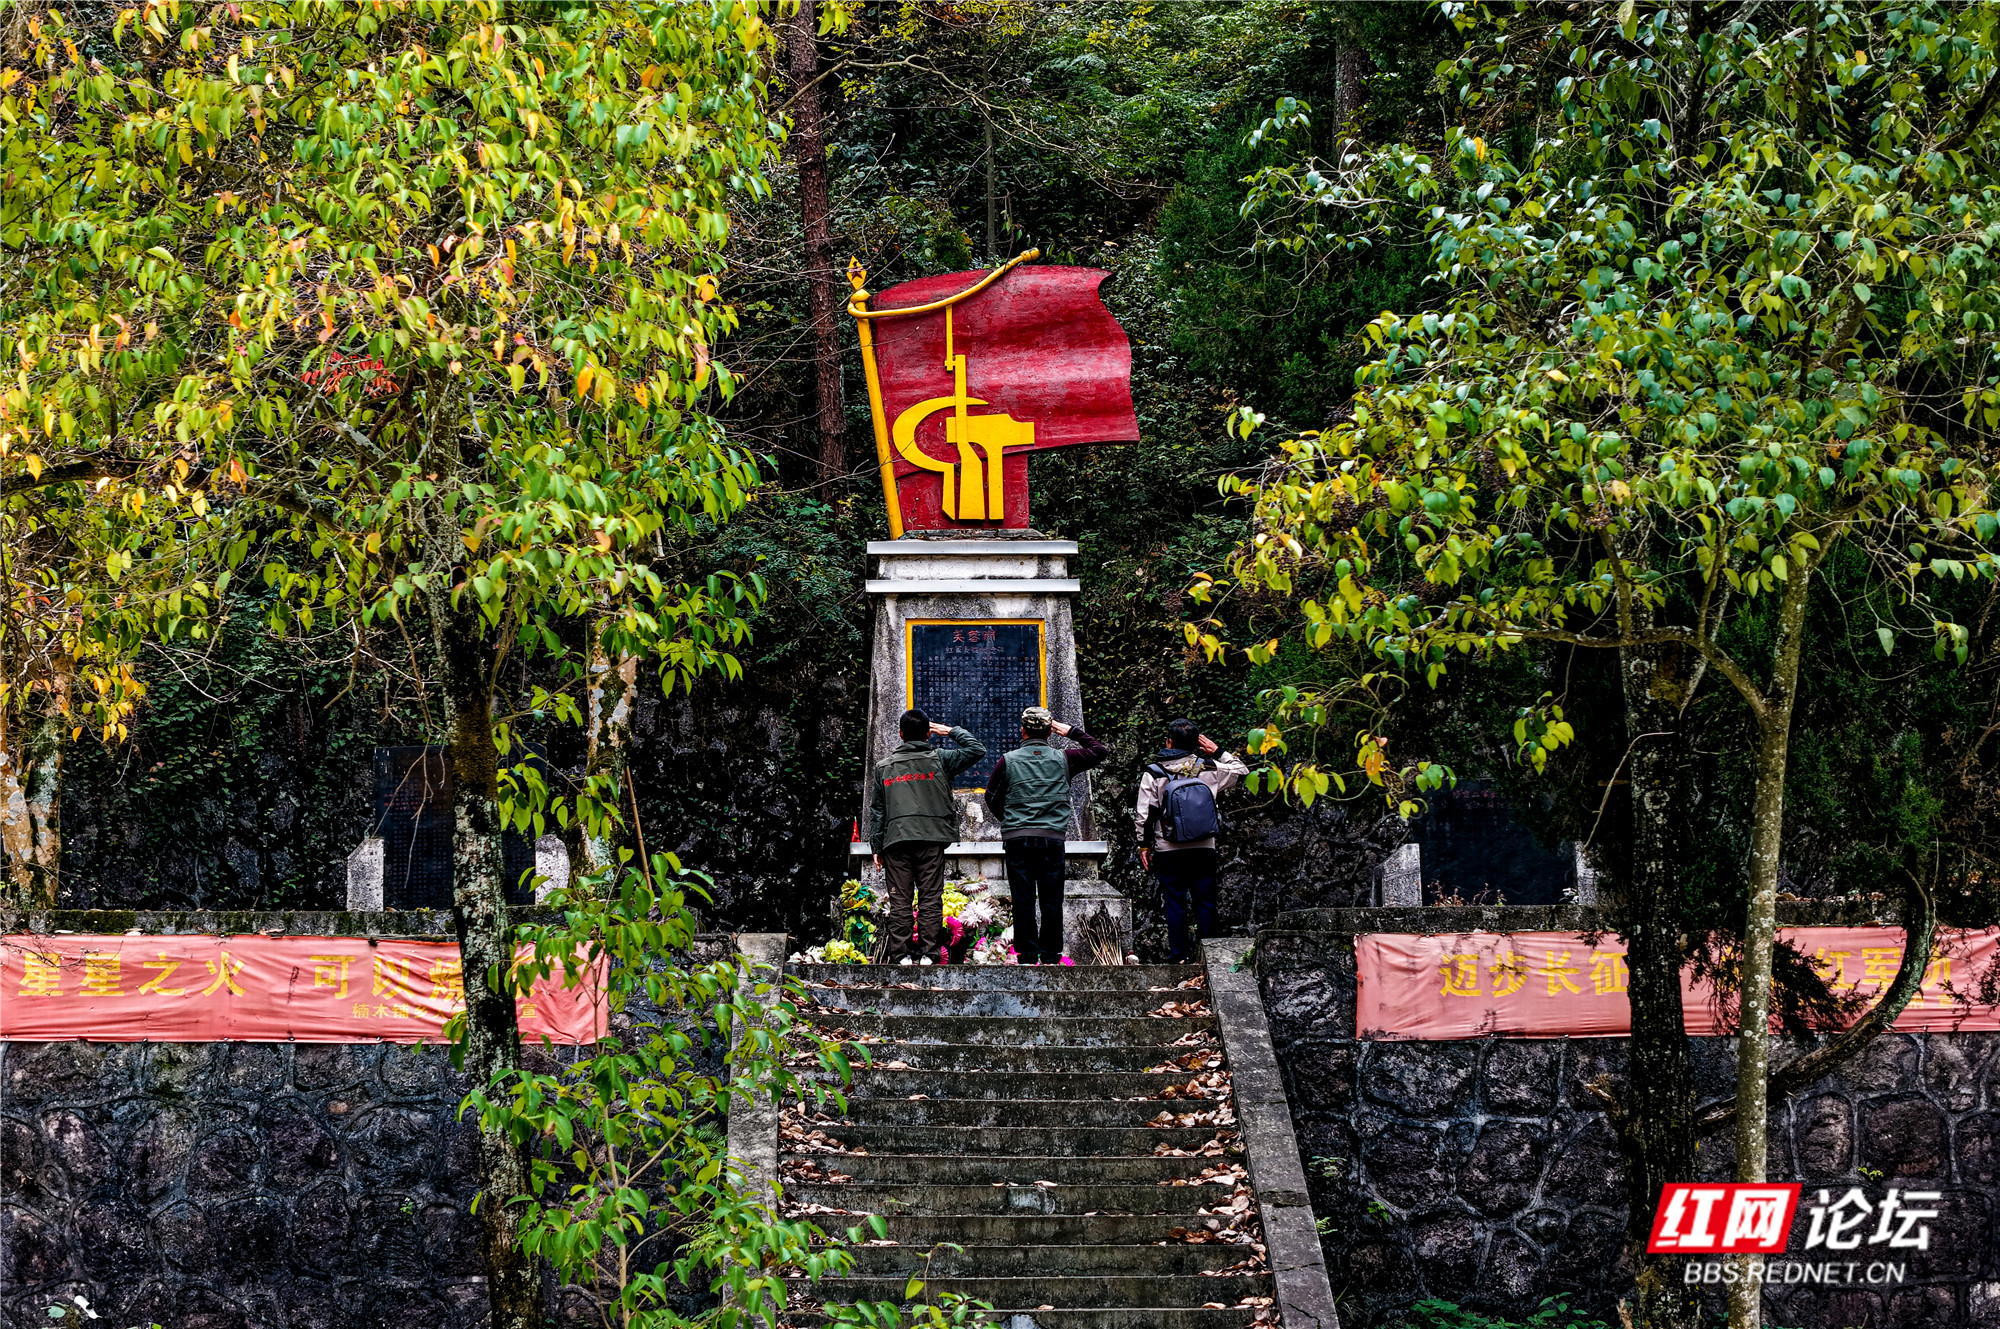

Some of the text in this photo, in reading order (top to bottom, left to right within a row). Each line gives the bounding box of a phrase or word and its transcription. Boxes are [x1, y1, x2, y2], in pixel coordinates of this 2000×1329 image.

[18, 950, 536, 1002] 星星之火 可以燎
[1439, 949, 1628, 998] 迈步长征
